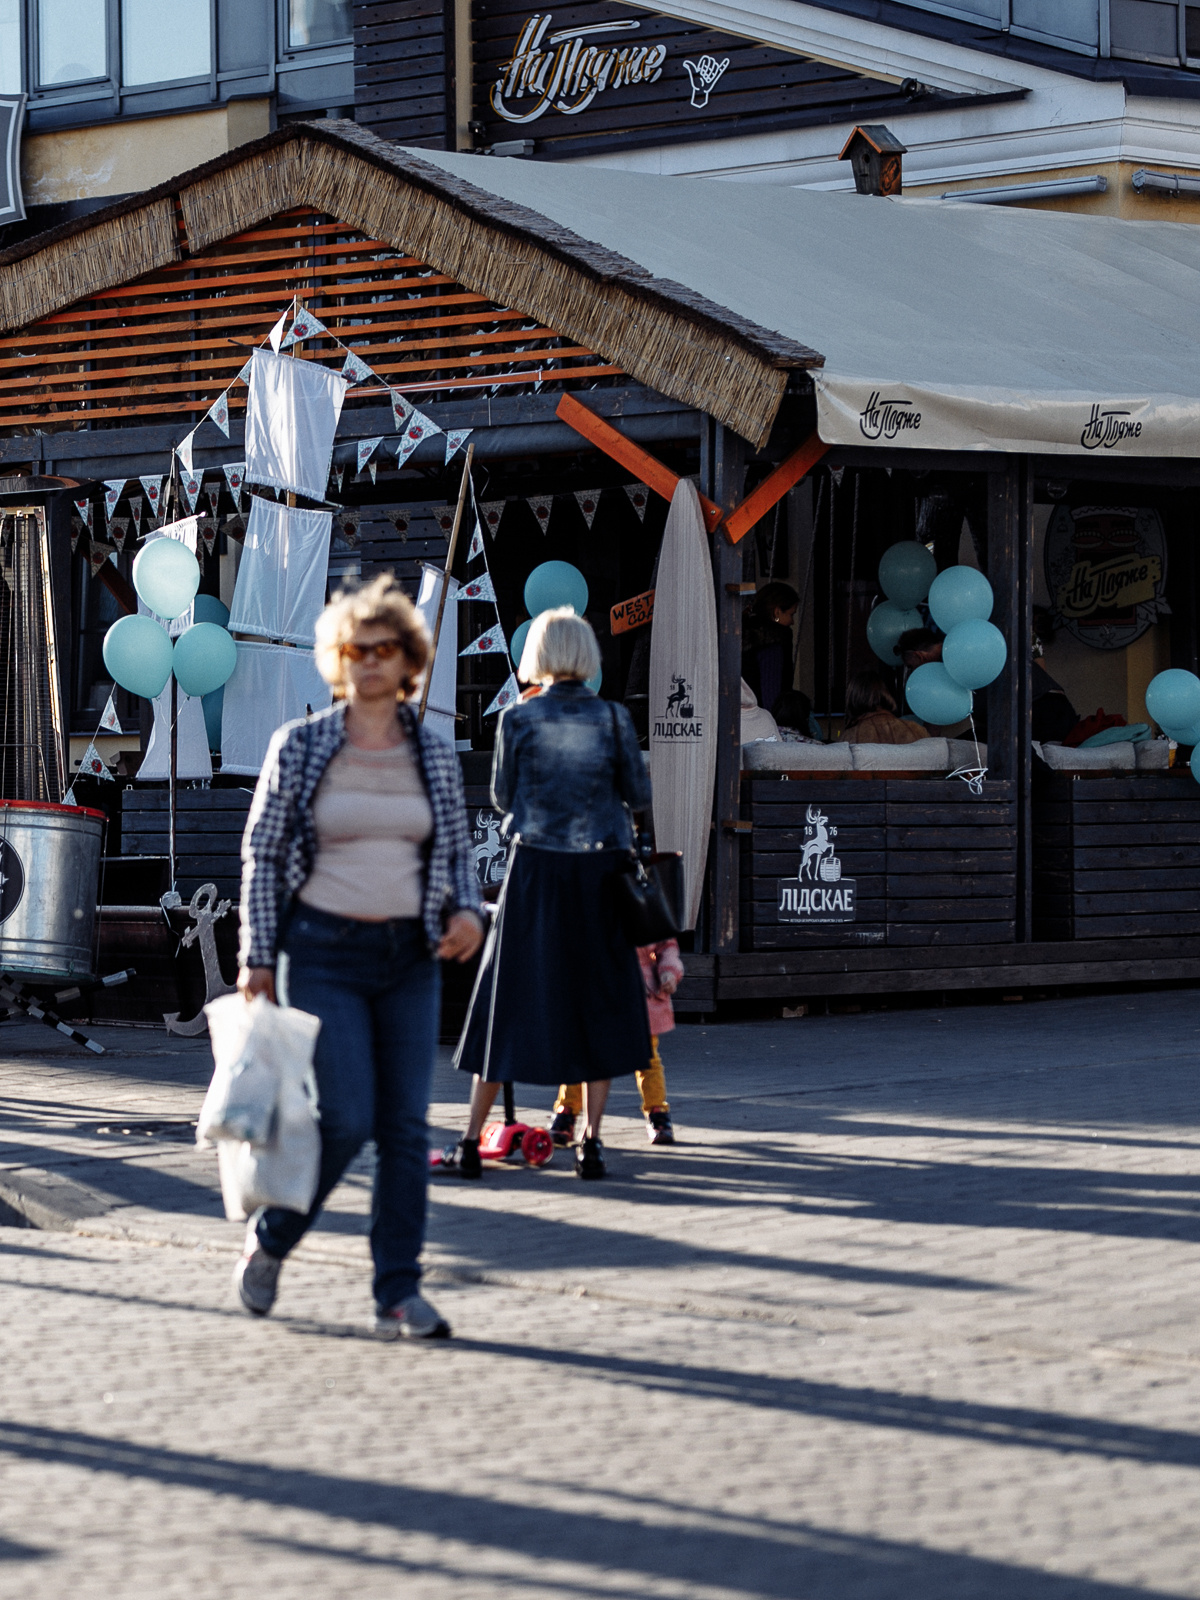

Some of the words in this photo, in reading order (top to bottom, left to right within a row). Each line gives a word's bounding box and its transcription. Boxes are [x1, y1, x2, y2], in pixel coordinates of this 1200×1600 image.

[612, 594, 653, 620] WEST
[627, 605, 655, 627] COA
[652, 723, 703, 738] ЛІДСКАЕ
[473, 830, 483, 840] 18
[804, 826, 813, 836] 18
[829, 826, 838, 836] 76
[779, 888, 854, 915] ЛІДСКАЕ
